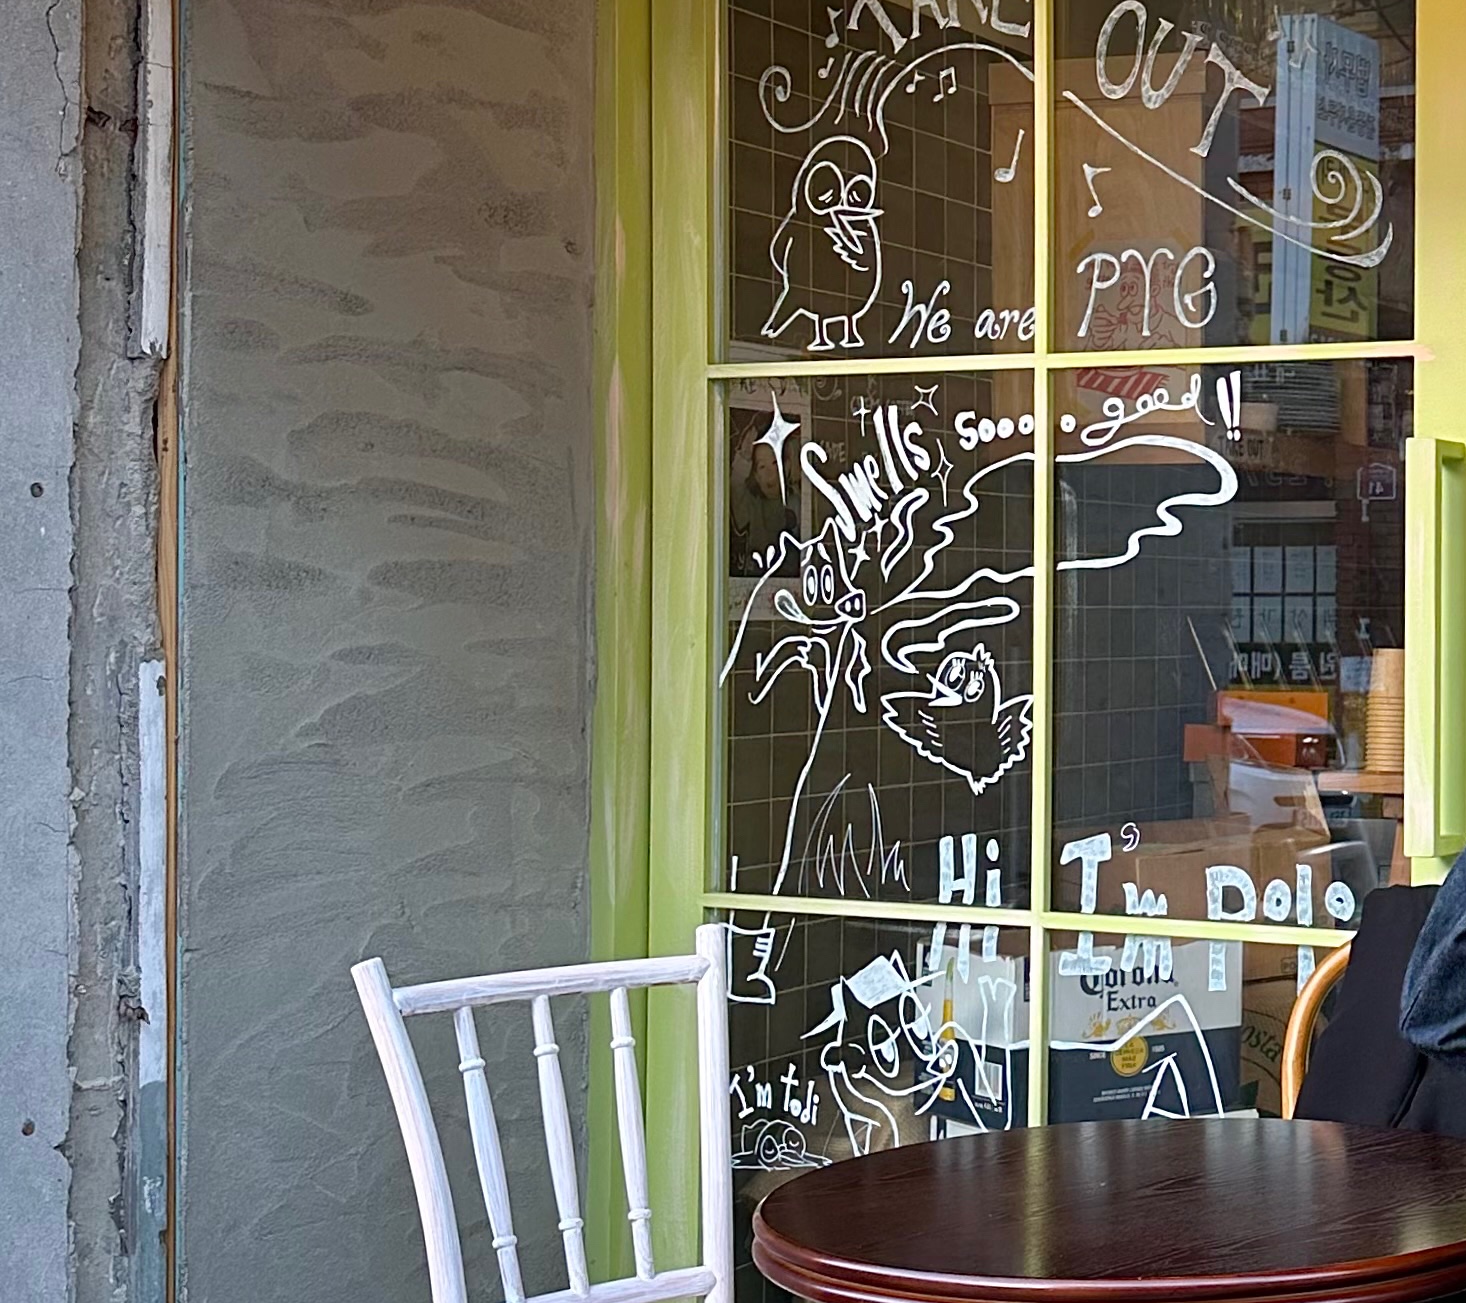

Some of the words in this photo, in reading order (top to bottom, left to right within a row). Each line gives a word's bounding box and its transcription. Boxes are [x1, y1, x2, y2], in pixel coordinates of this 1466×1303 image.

[1095, 0, 1271, 158] OUT
[887, 280, 952, 349] We
[974, 304, 1036, 342] are
[1076, 245, 1217, 338] PYG
[800, 404, 931, 542] Smells
[929, 833, 1002, 984] Hi
[1106, 990, 1157, 1012] Extra
[729, 1065, 773, 1120] I'm
